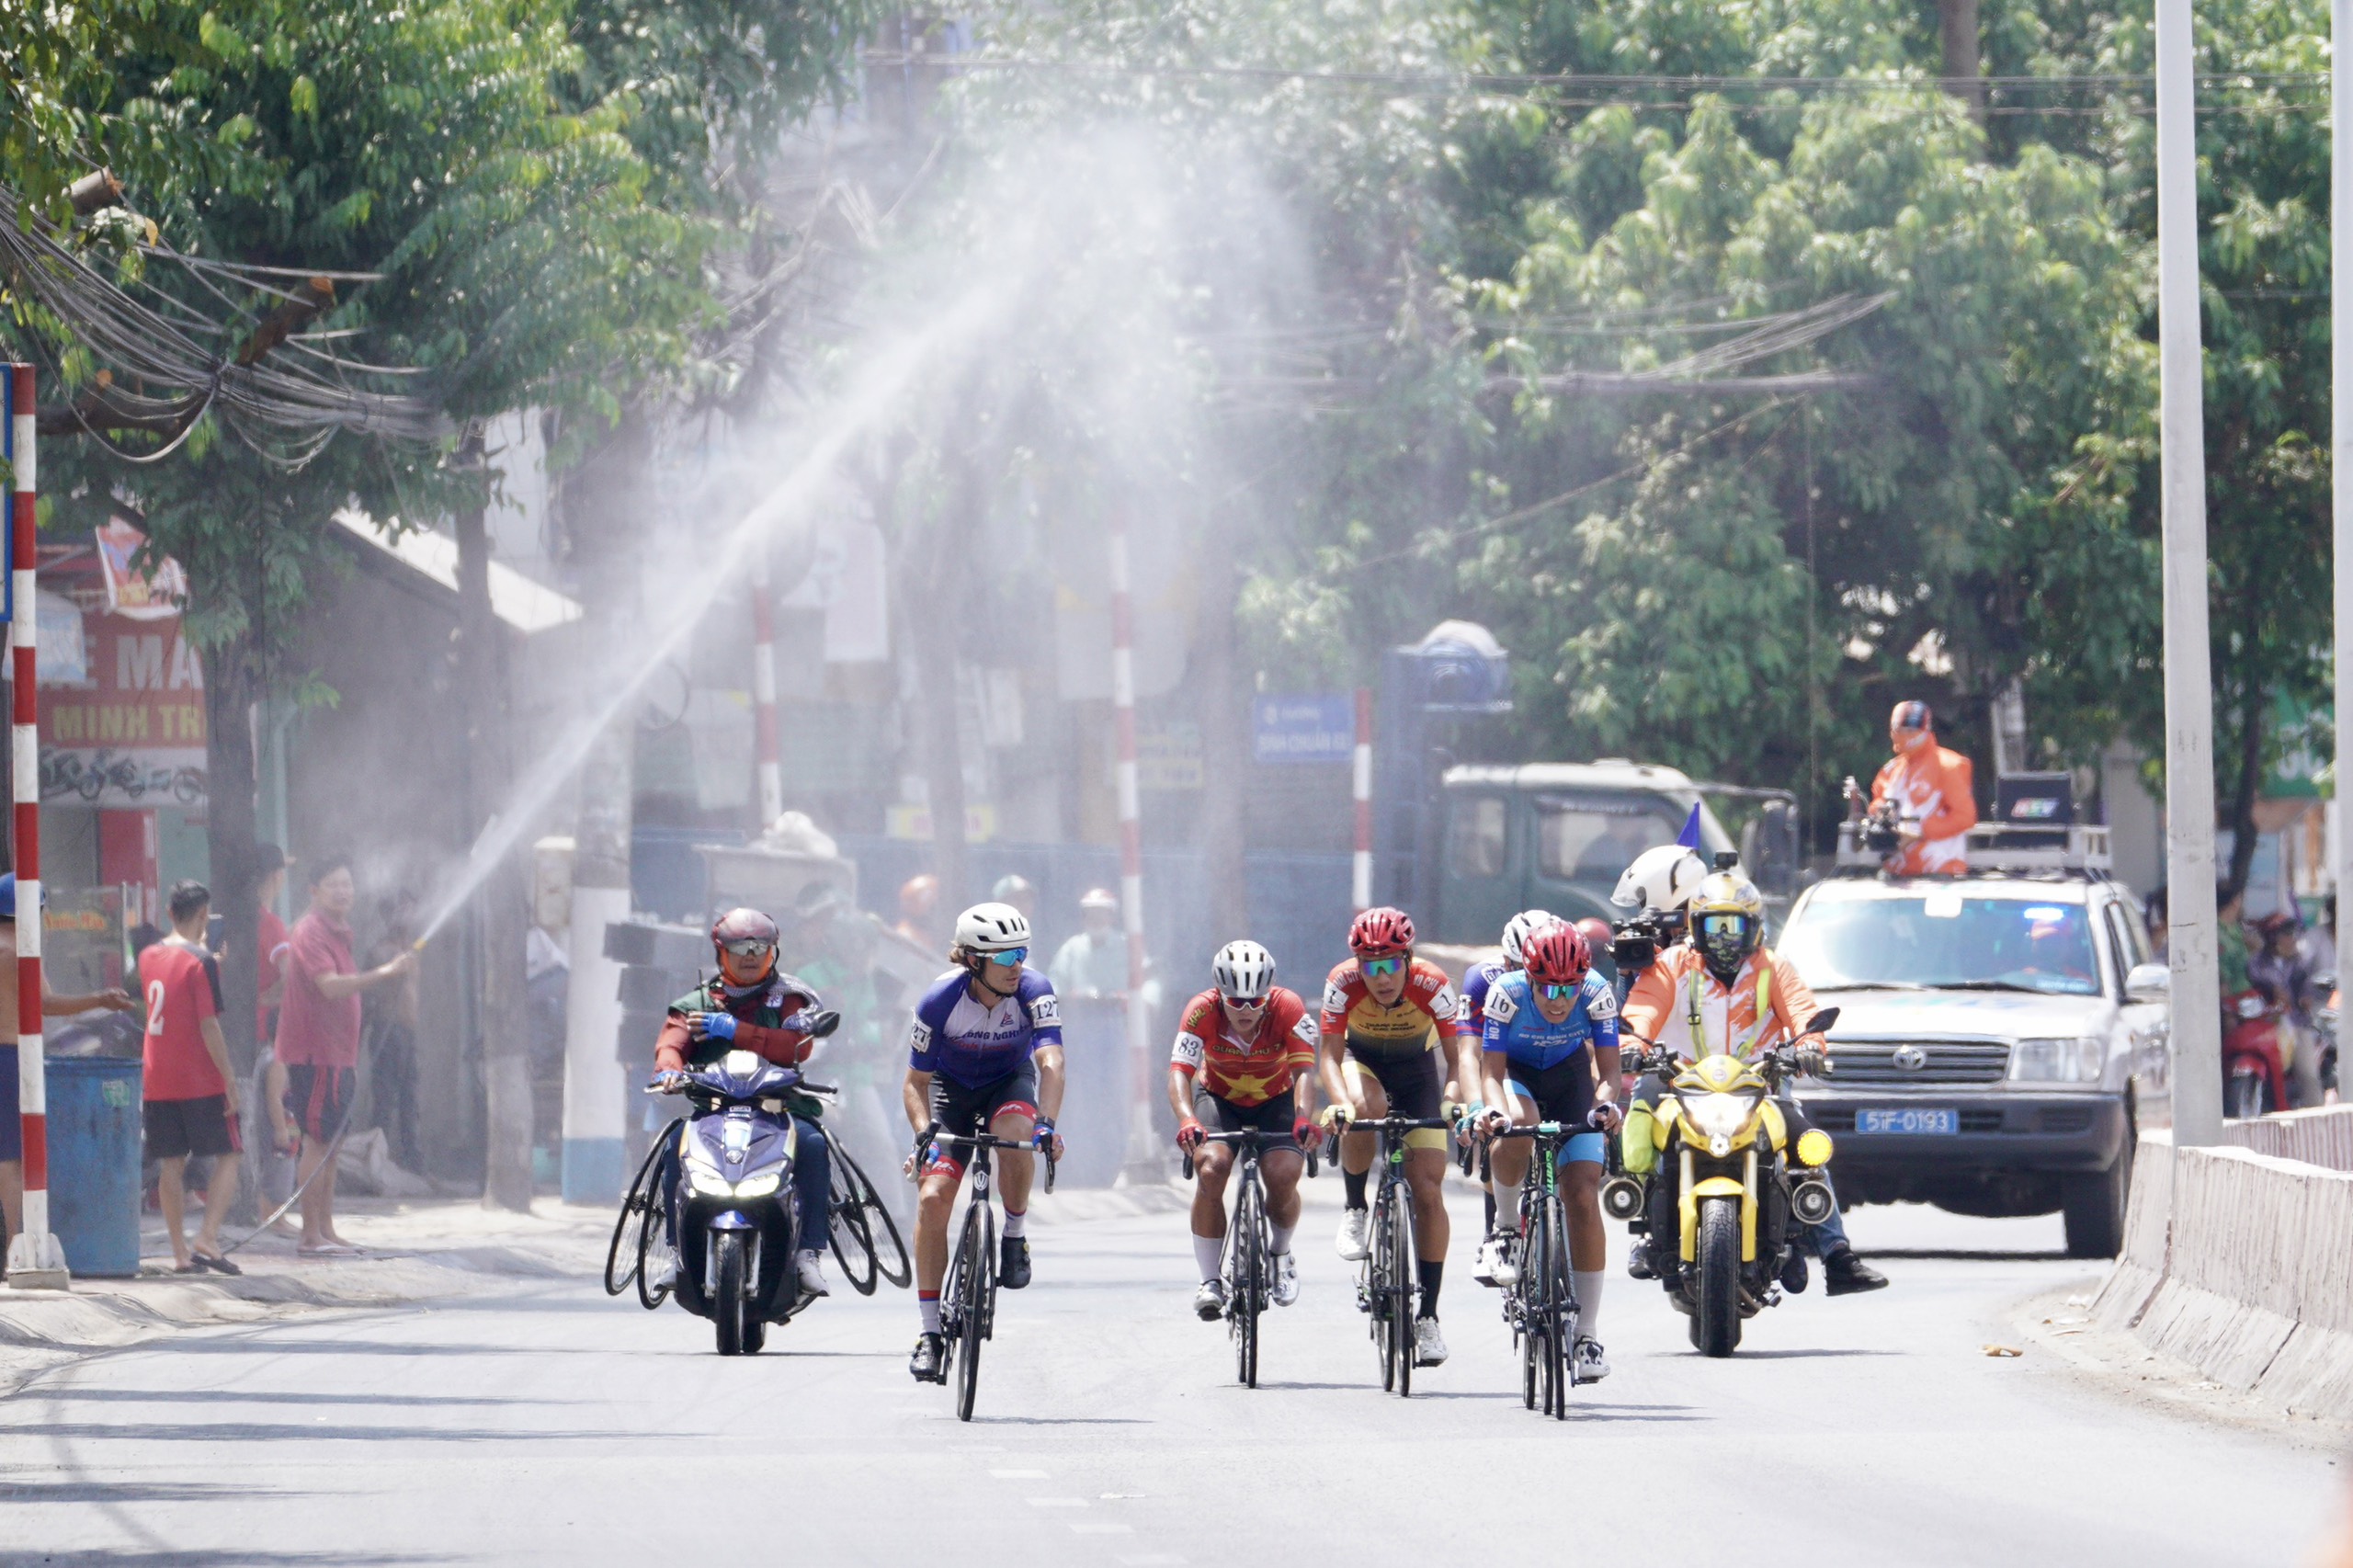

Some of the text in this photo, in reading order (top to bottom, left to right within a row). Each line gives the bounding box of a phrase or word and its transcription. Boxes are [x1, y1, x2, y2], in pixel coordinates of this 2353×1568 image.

[52, 705, 150, 741] MINH
[148, 980, 165, 1036] 2
[1440, 993, 1452, 1008] 1
[1490, 992, 1510, 1014] 16
[1178, 1037, 1199, 1057] 83
